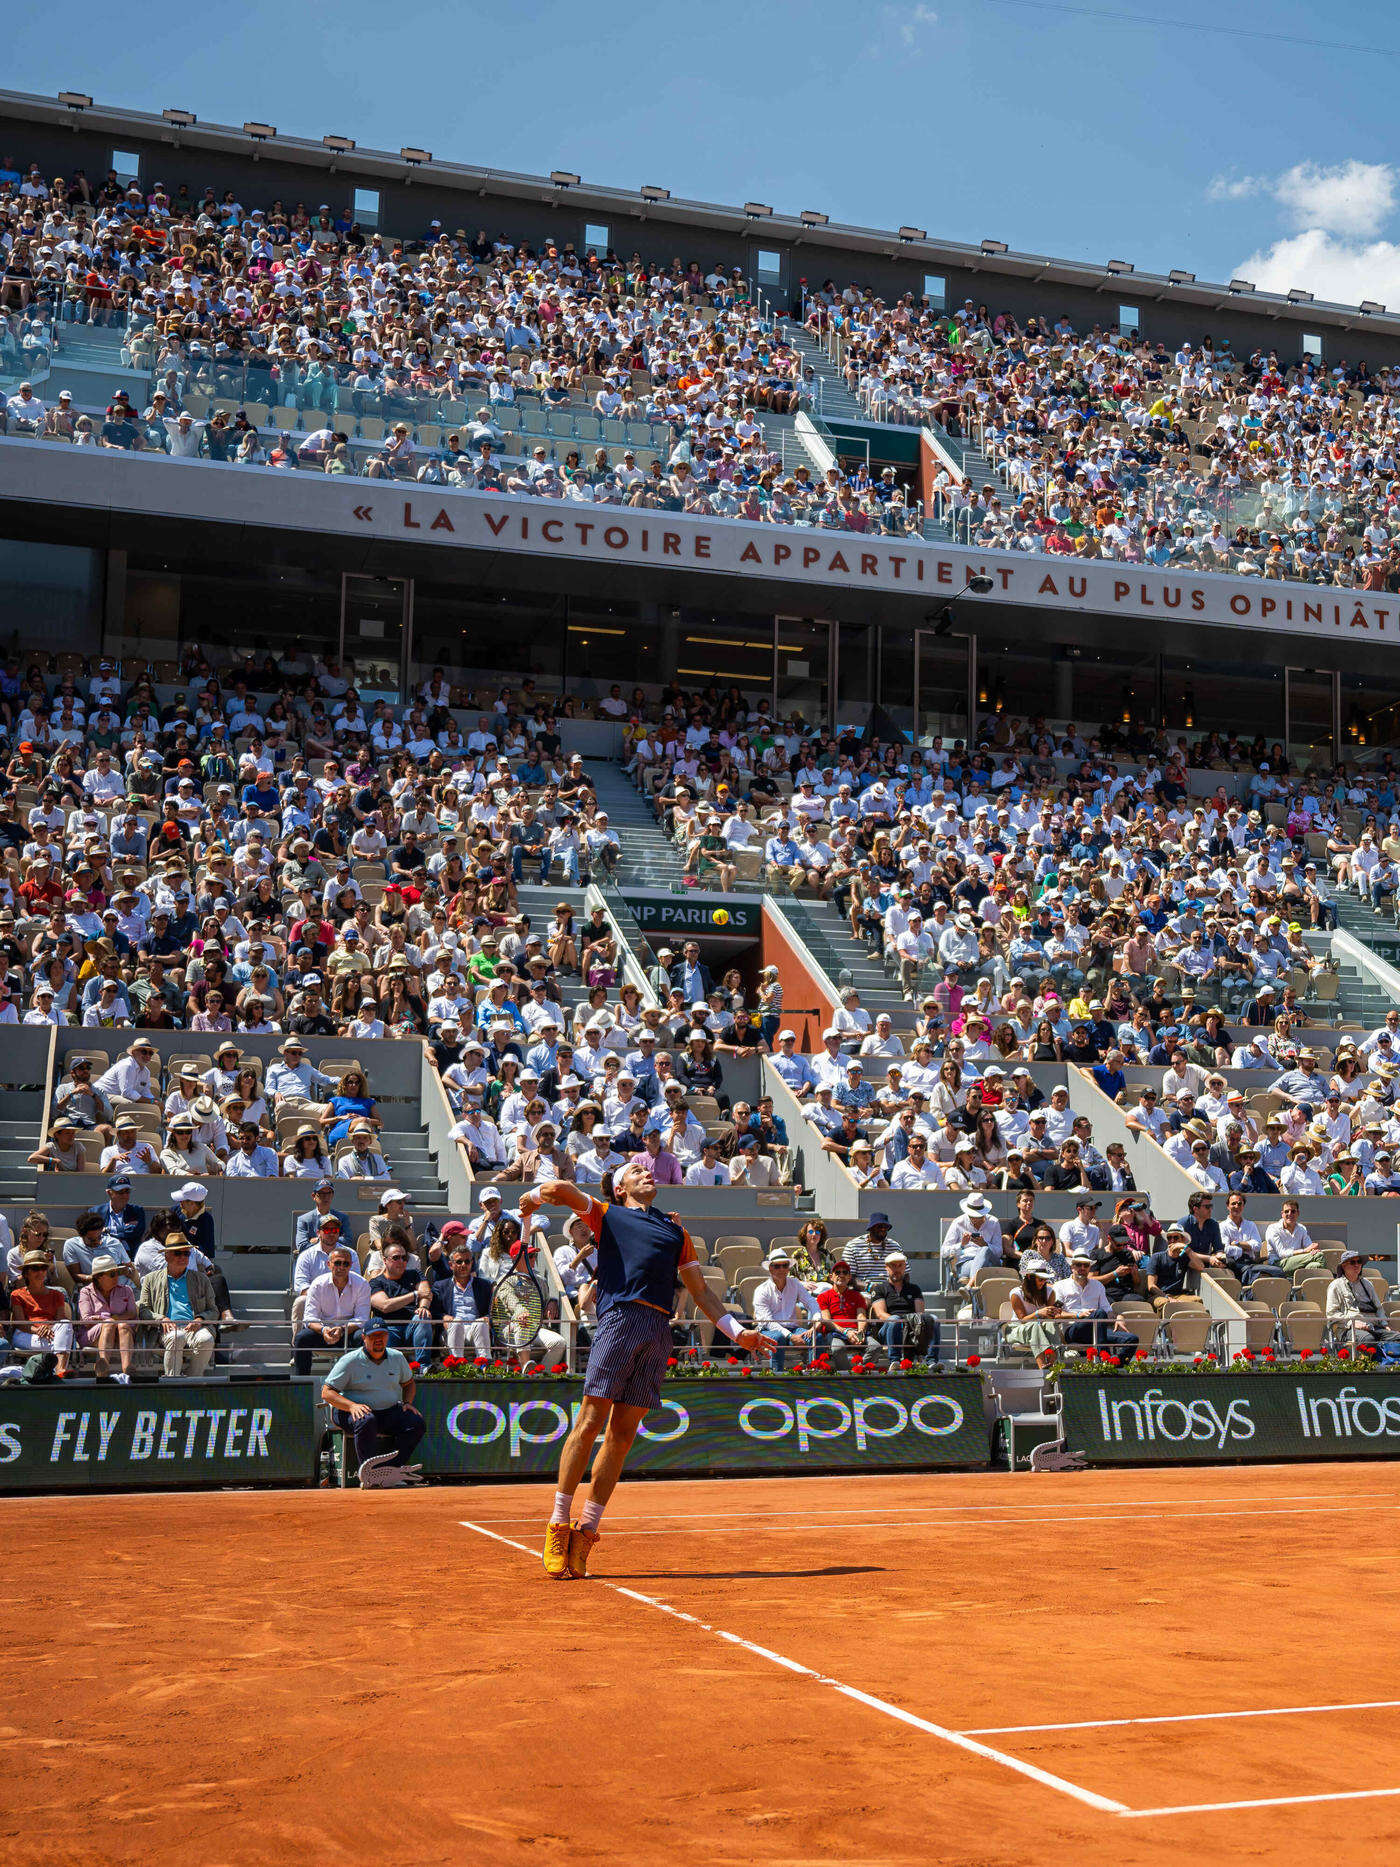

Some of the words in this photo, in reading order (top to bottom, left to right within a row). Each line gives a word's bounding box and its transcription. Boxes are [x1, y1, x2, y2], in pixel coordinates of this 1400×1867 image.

[404, 503, 455, 532] LA
[484, 513, 712, 558] VICTOIRE
[740, 541, 1014, 589] APPARTIENT
[1038, 574, 1087, 598] AU
[1114, 581, 1206, 610] PLUS
[630, 905, 656, 920] NP
[50, 1411, 121, 1462] FLY
[129, 1408, 273, 1461] BETTER
[447, 1399, 690, 1457] opo
[738, 1395, 965, 1452] oppo
[1097, 1388, 1256, 1450] Infosys
